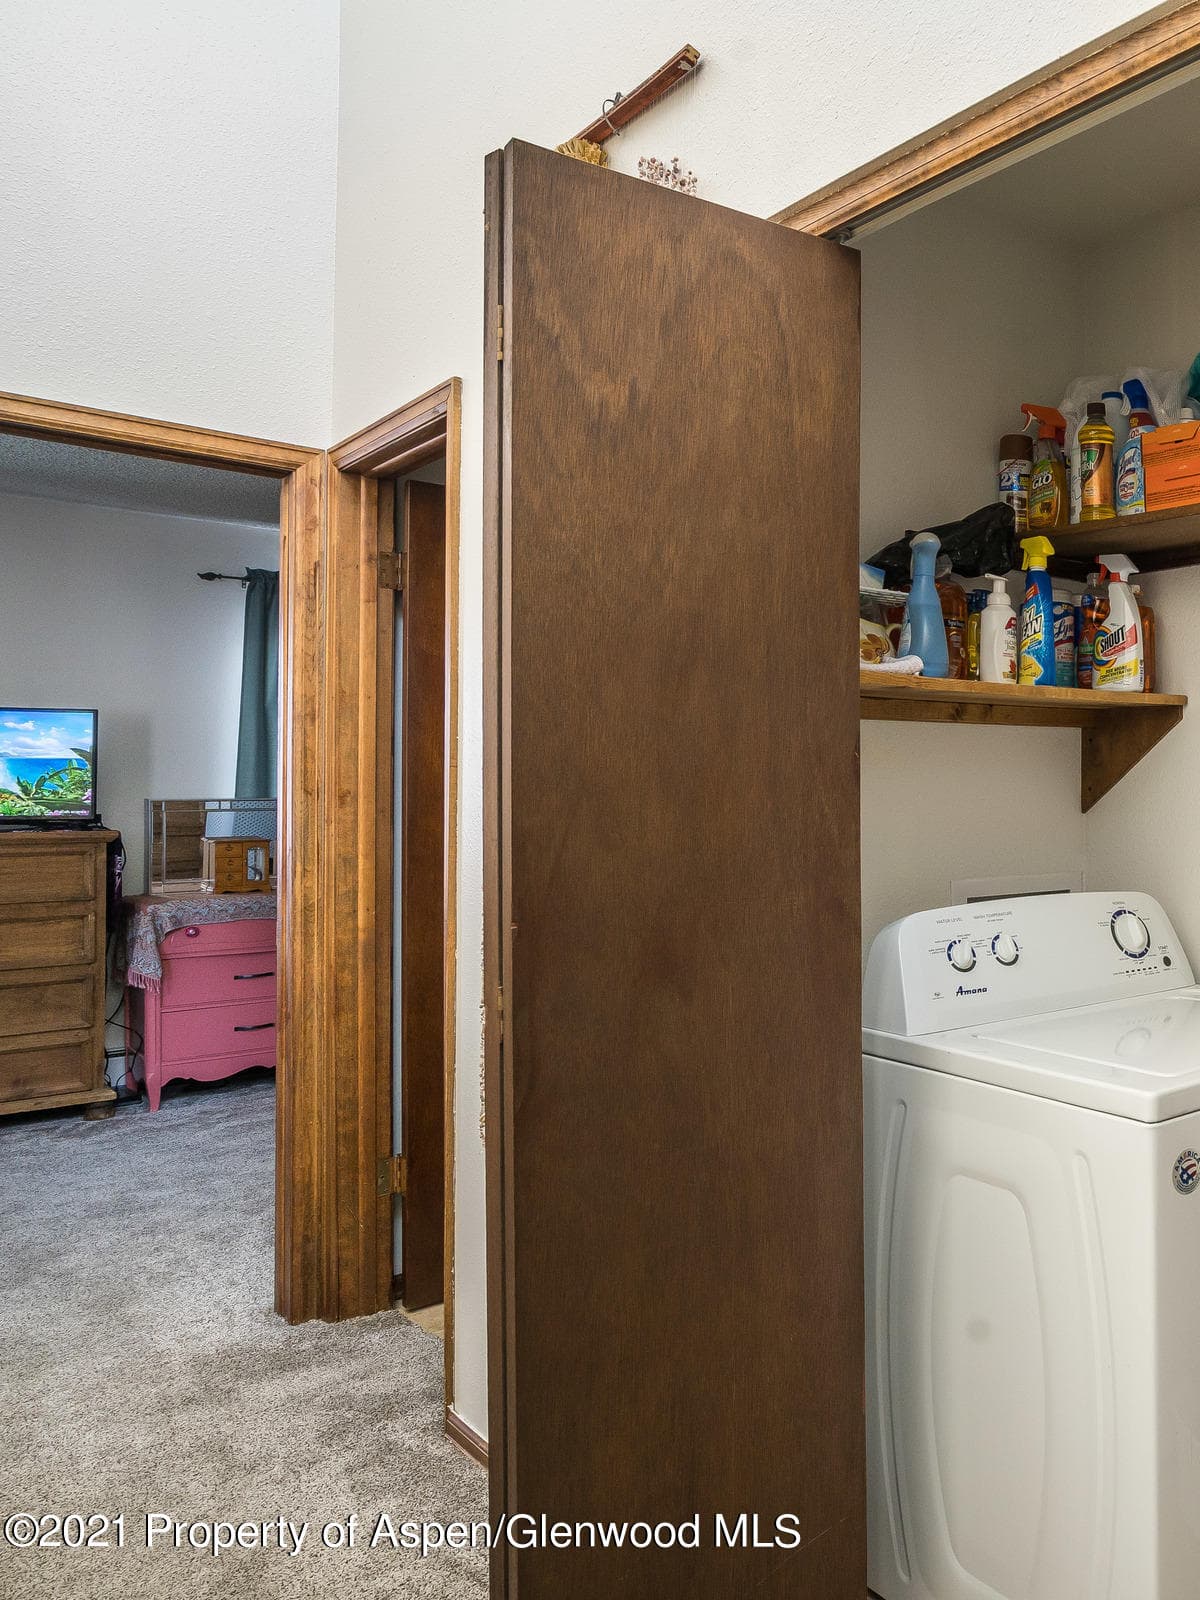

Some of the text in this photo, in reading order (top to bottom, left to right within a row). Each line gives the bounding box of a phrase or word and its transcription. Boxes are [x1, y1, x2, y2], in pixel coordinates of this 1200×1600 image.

[1024, 604, 1036, 622] XI
[1022, 616, 1043, 640] EAN
[1100, 624, 1126, 654] SHOUT
[955, 985, 988, 998] Amana
